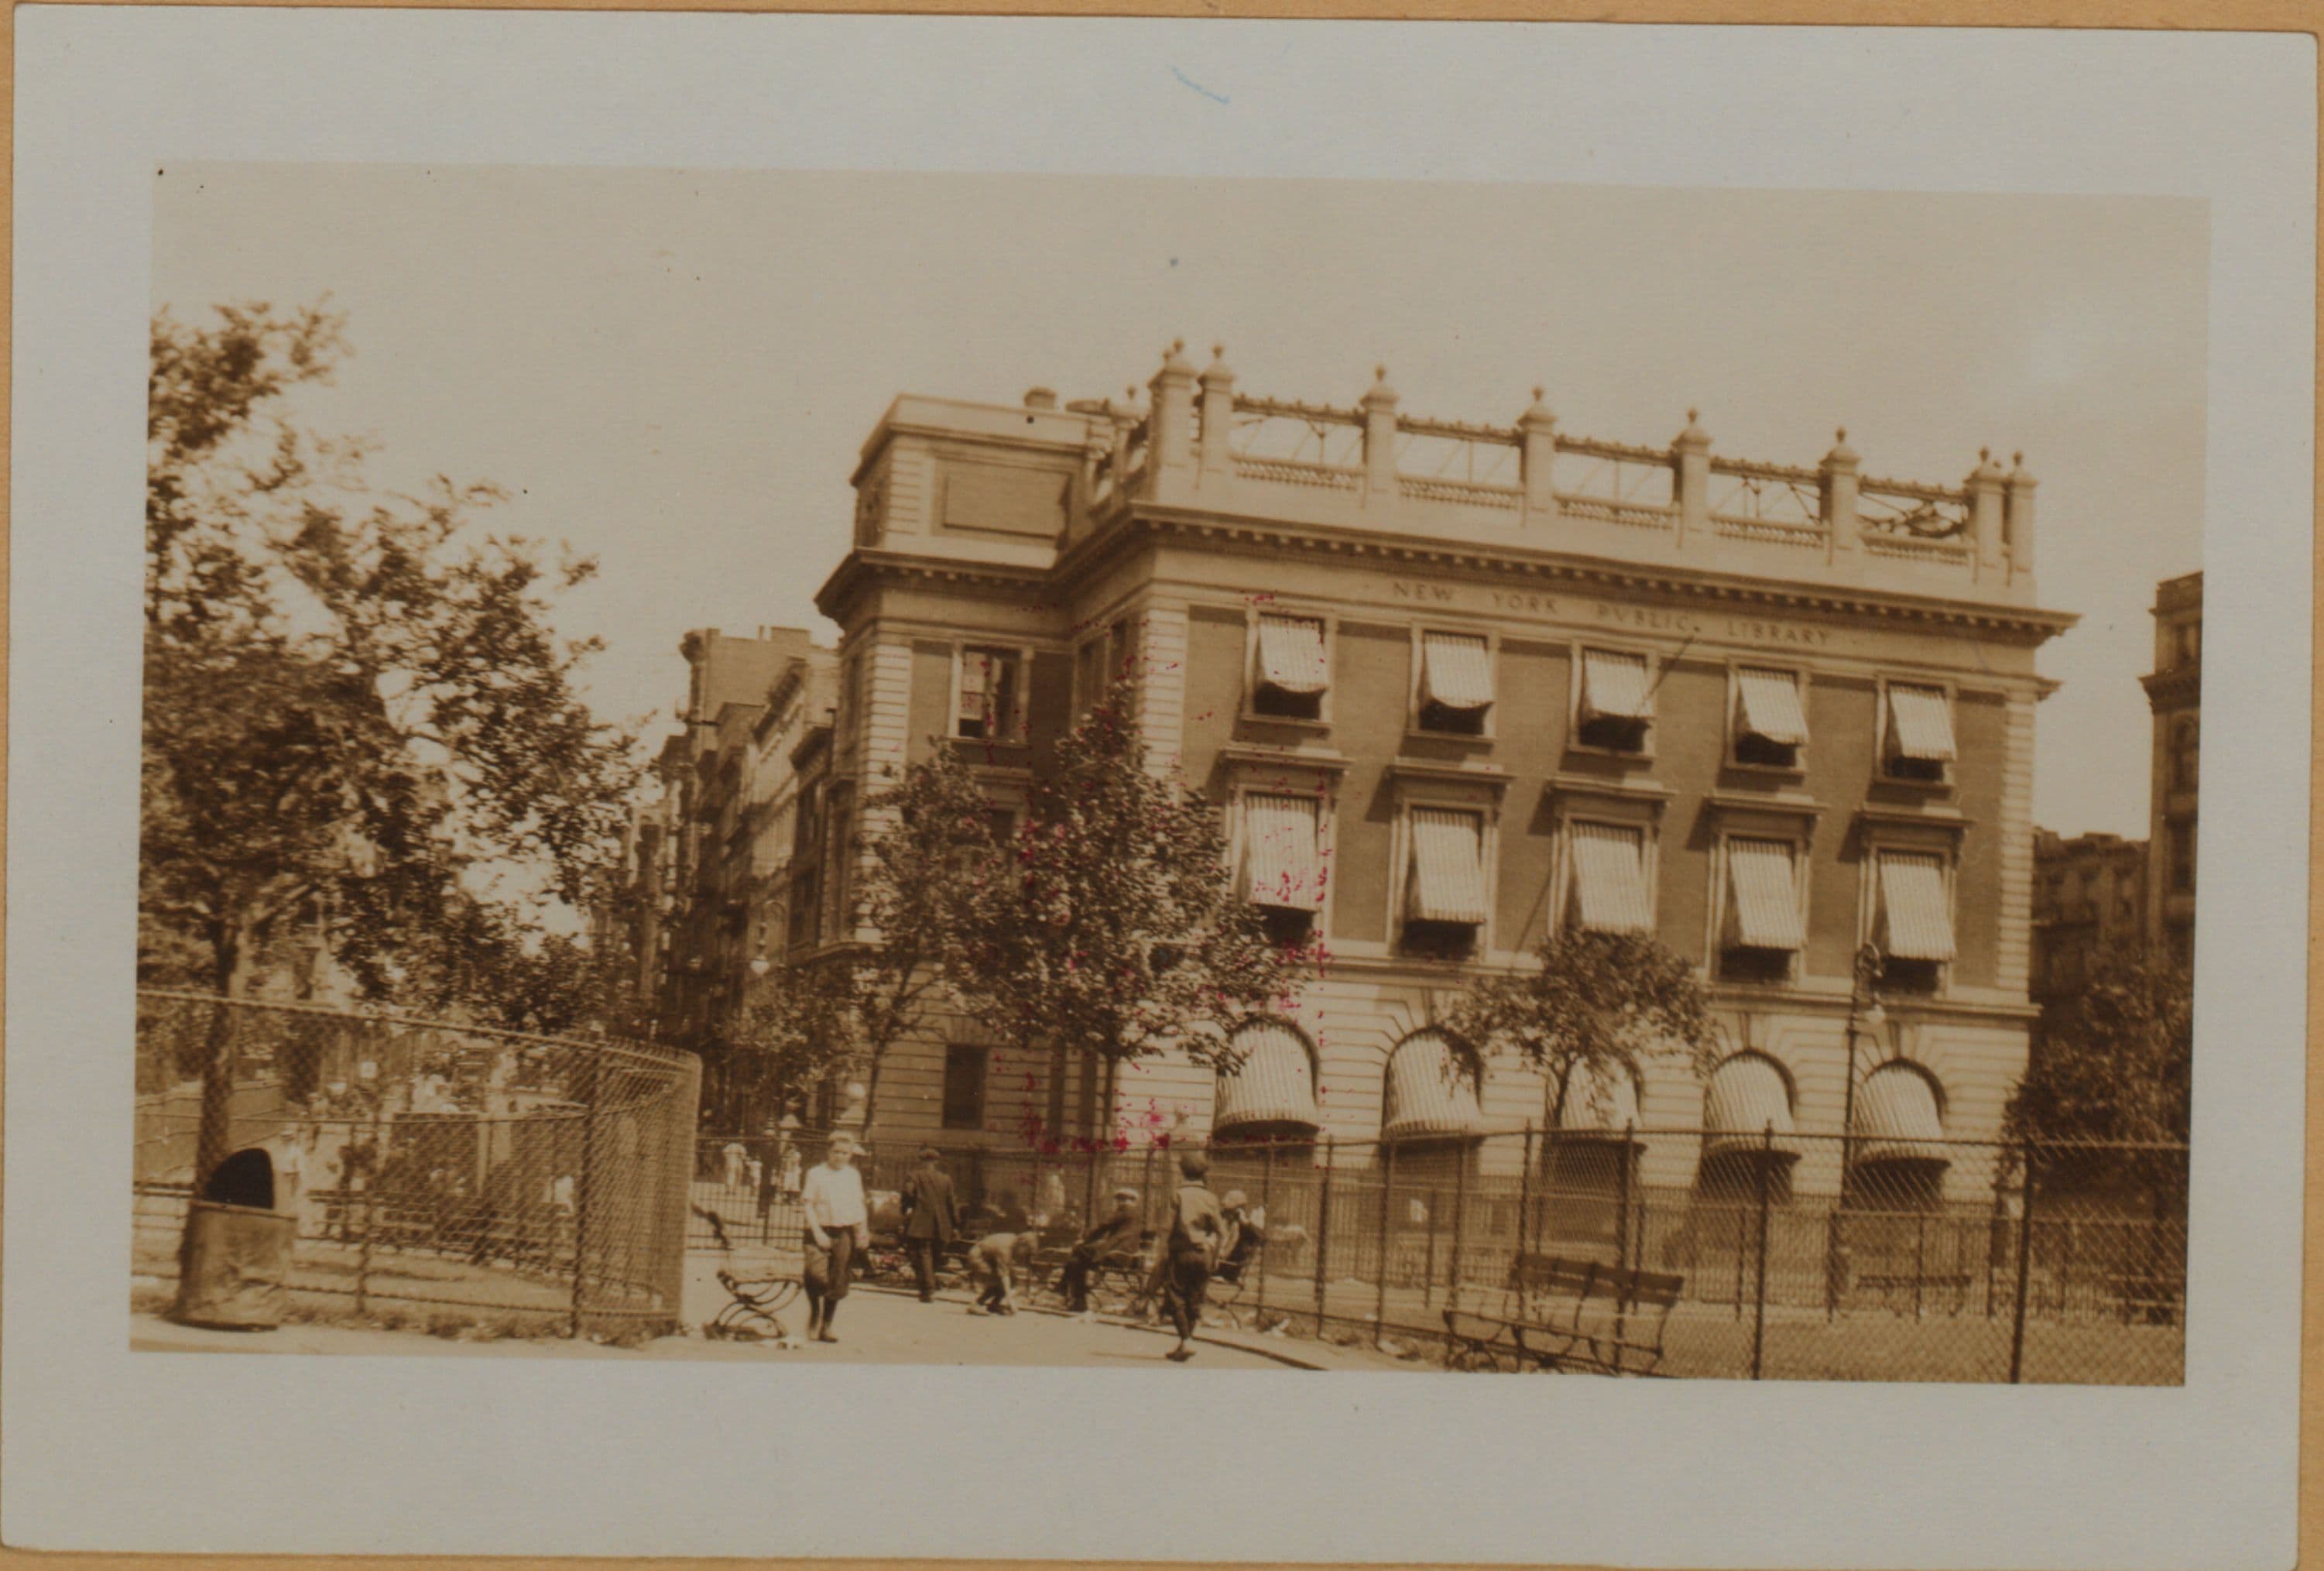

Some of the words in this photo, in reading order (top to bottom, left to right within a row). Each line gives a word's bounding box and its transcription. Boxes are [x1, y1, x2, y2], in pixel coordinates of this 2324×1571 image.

[1394, 582, 1451, 602] NEW
[1493, 592, 1558, 614] YORK
[1727, 620, 1830, 647] LIBRARY
